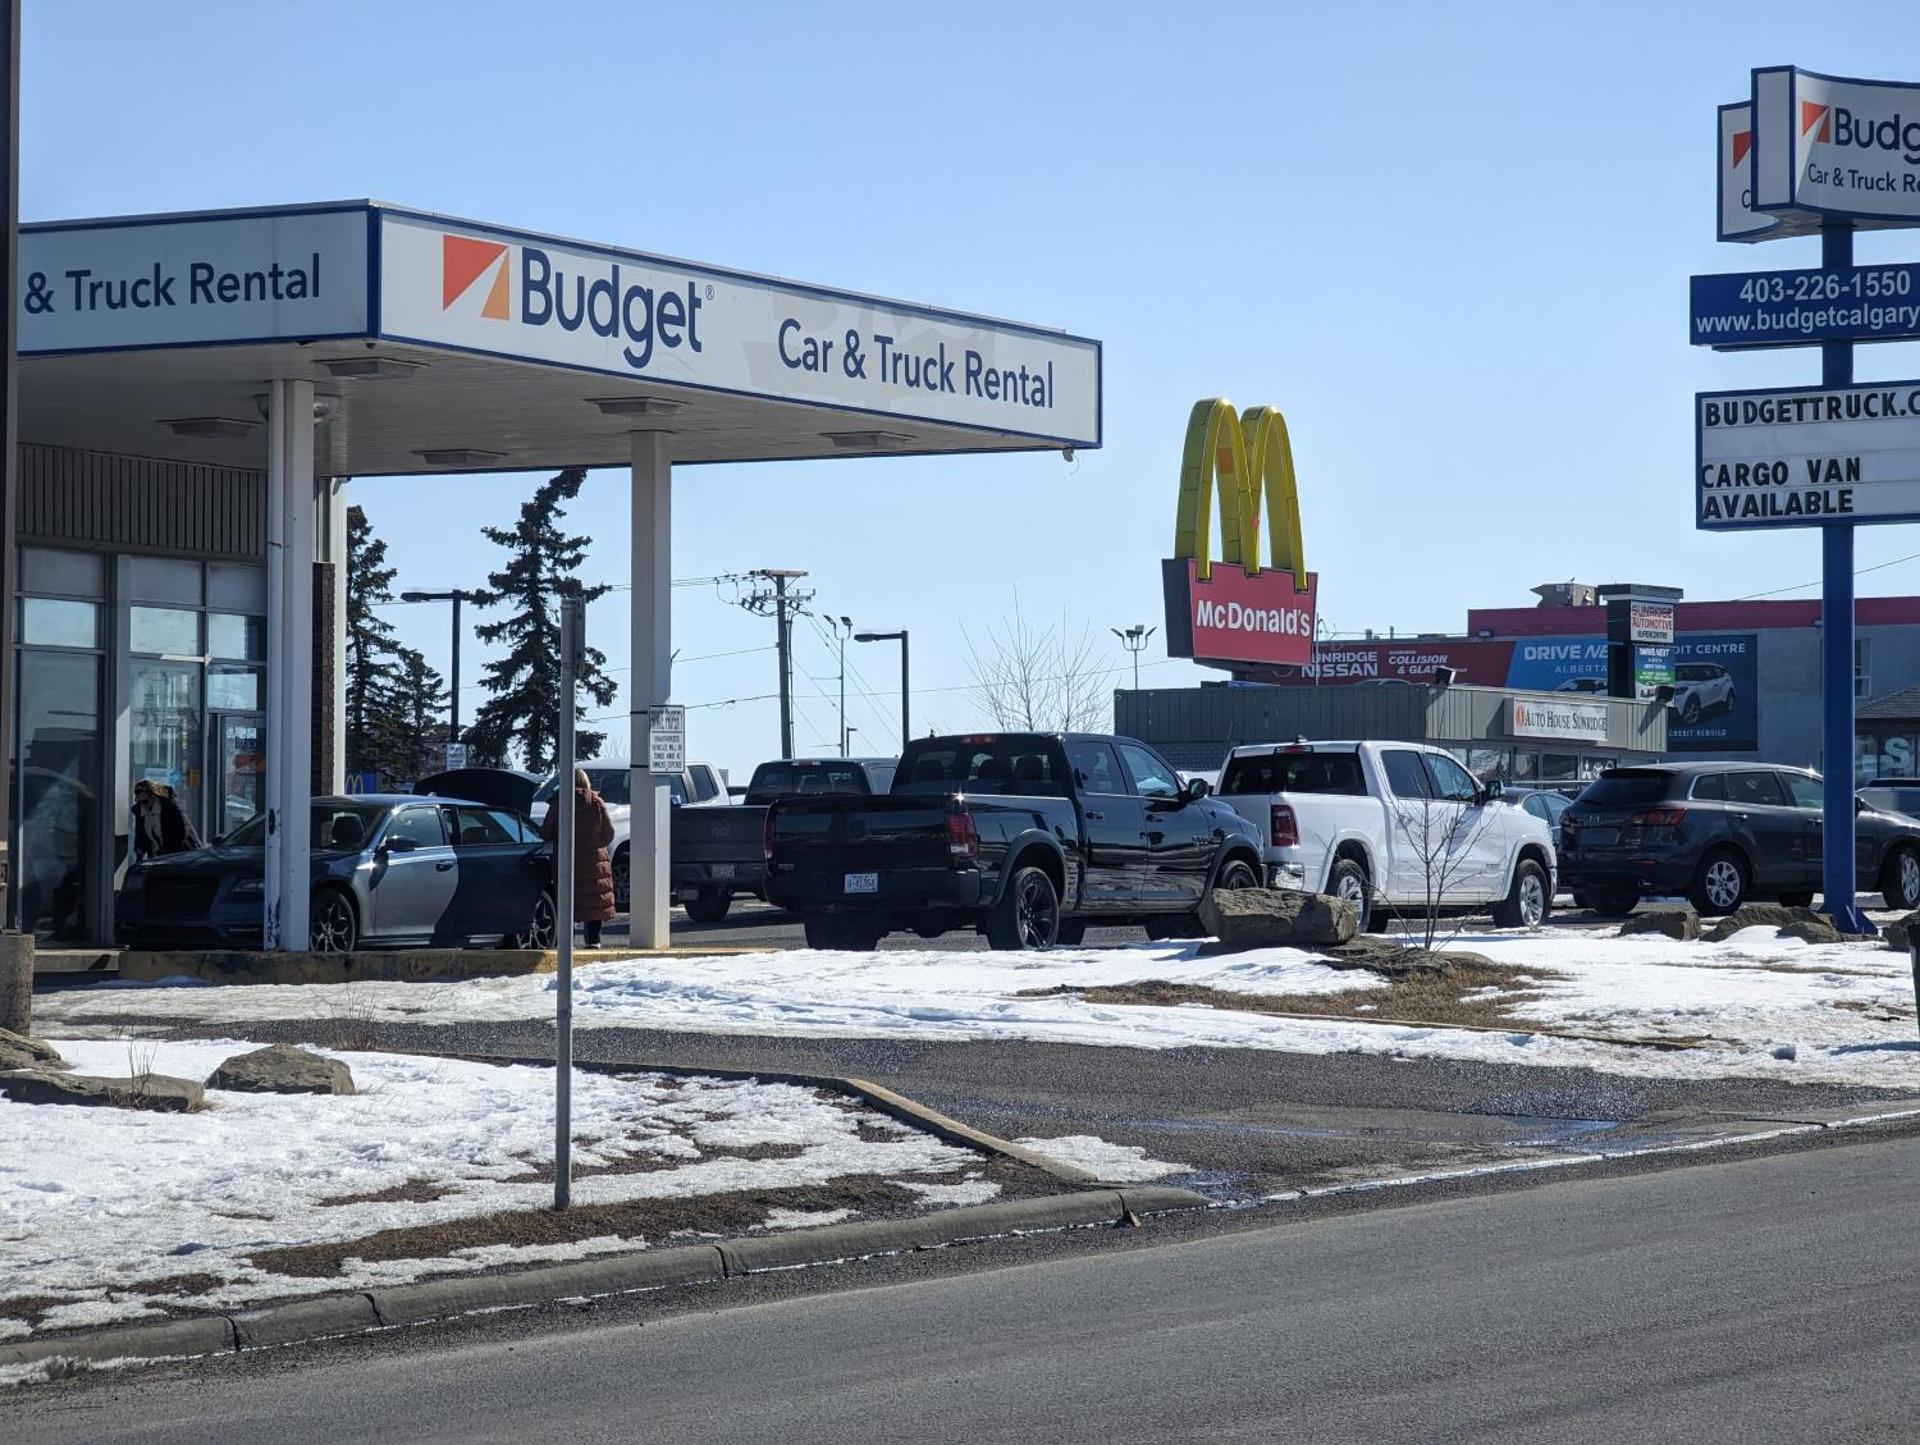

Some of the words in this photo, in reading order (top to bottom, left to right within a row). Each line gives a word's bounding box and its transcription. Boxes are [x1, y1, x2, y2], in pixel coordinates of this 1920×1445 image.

[1807, 162, 1830, 185] Car
[1832, 167, 1844, 188] &
[1847, 168, 1897, 192] Truck
[24, 271, 55, 315] &
[65, 262, 177, 311] Truck
[190, 252, 320, 305] Rental
[1739, 270, 1911, 303] 403-226-1550
[778, 318, 834, 373] Car
[842, 328, 867, 381] &
[873, 334, 956, 394] Truck
[964, 349, 1053, 409] Rental
[1702, 460, 1789, 488] CARGO
[1806, 456, 1861, 484] VAN
[1704, 489, 1854, 519] AVAILABLE
[1196, 599, 1311, 637] McDonald's
[1388, 654, 1449, 665] COLLISION
[1524, 645, 1582, 660] DRIVE
[1695, 643, 1746, 655] CENTRE
[1554, 664, 1608, 674] ALBERTA
[1525, 708, 1546, 728] AUTO
[1547, 709, 1571, 730] HOUSE
[1572, 712, 1607, 732] SUNRIDGE
